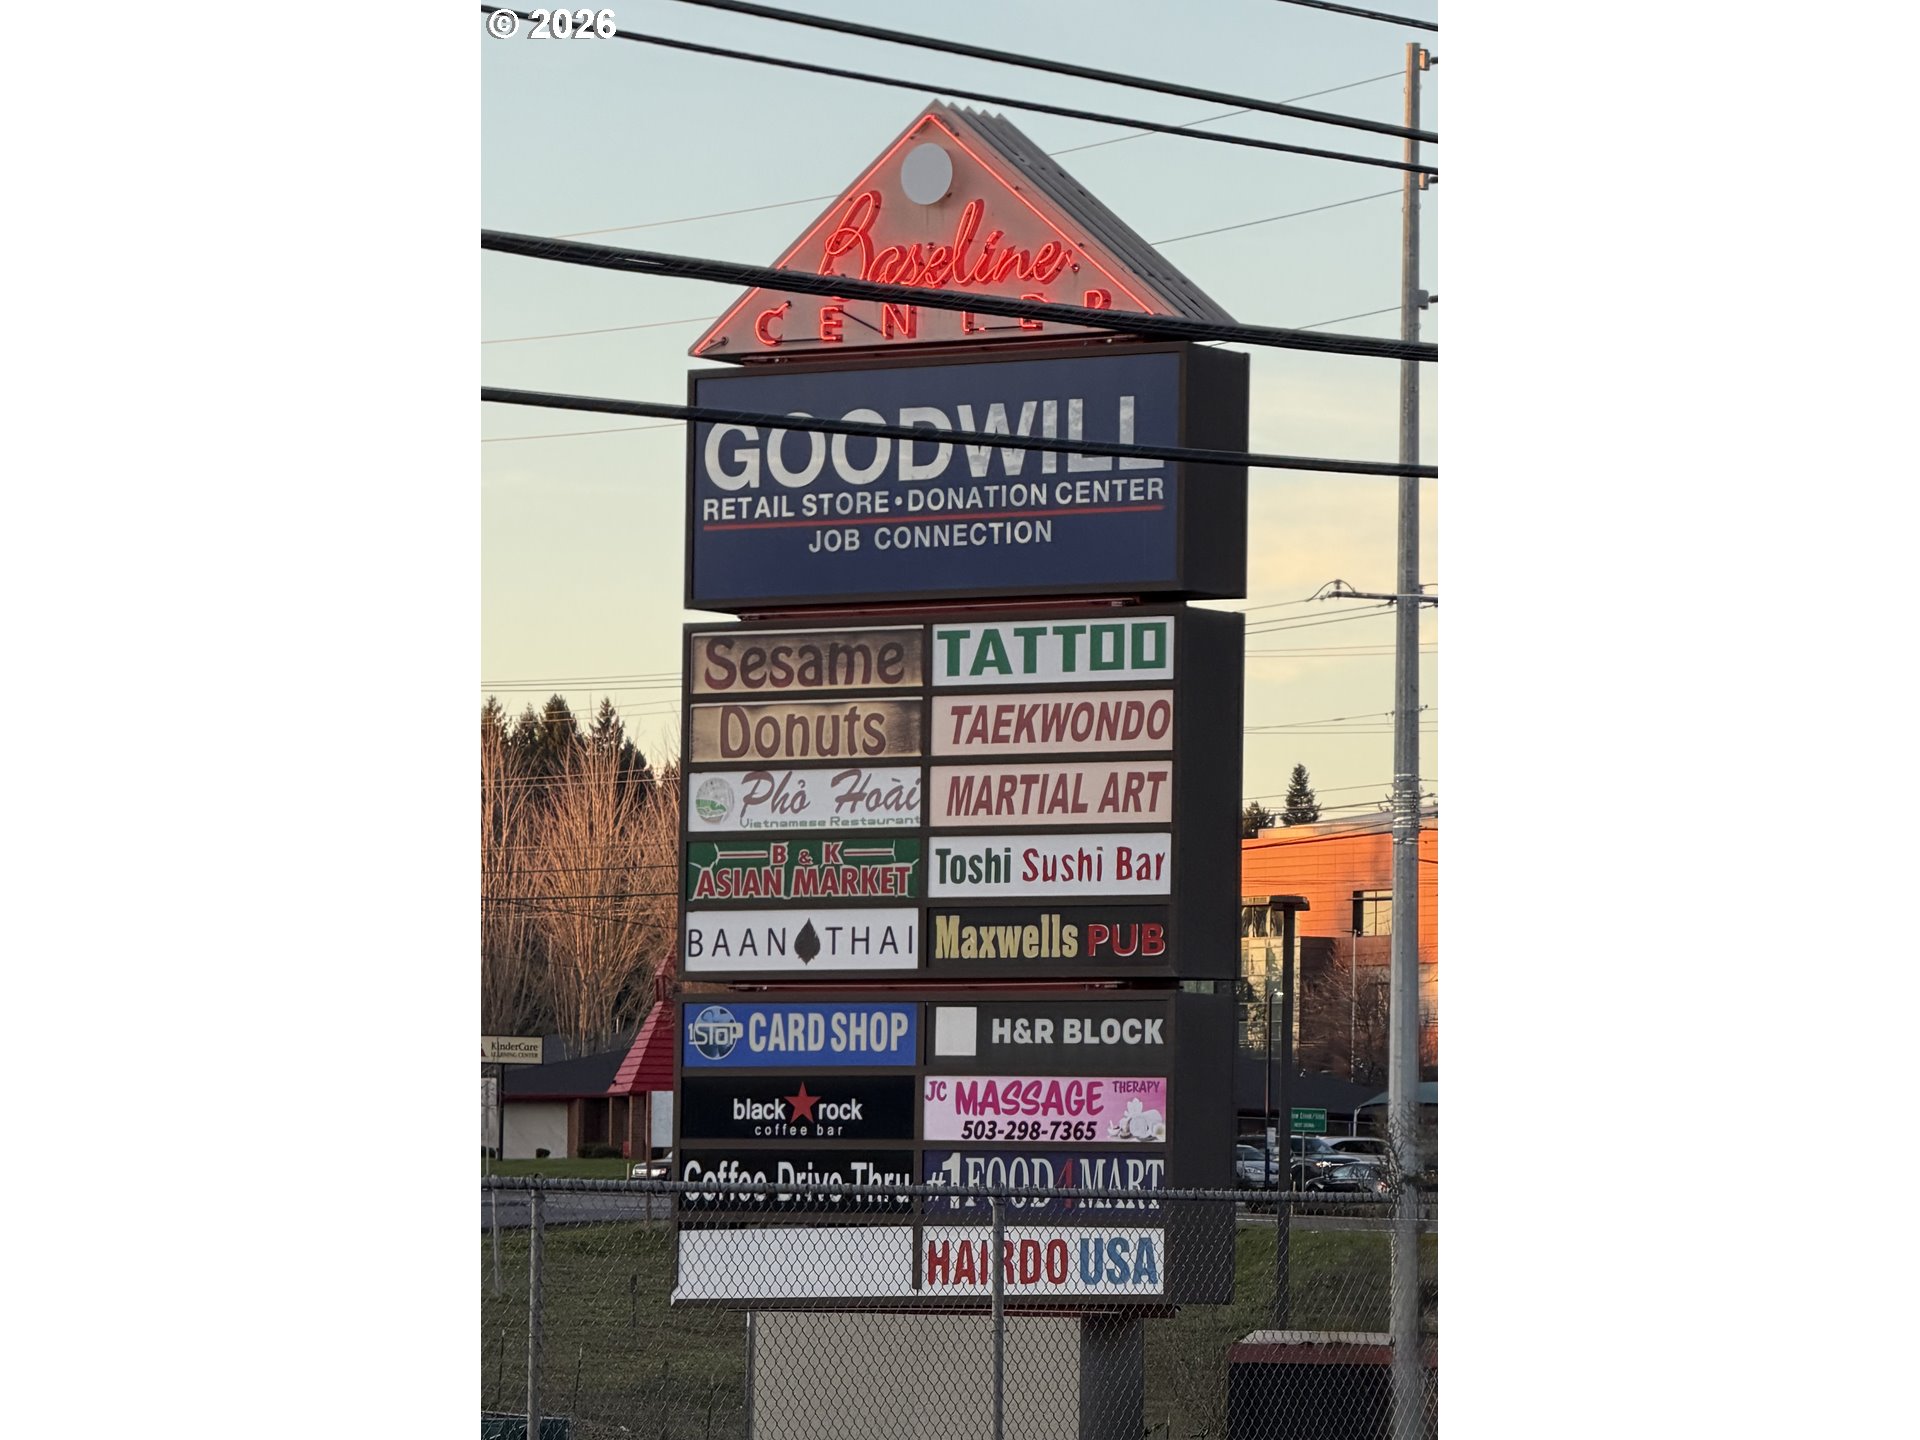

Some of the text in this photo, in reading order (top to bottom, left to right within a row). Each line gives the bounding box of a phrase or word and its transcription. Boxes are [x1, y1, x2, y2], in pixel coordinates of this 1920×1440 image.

[818, 189, 1074, 300] Baseline
[703, 395, 1165, 491] GOODWILL
[703, 477, 1165, 522] RETAIL STORE DONATION CENTER
[808, 519, 1053, 554] JOB CONNECTION
[704, 637, 906, 691] Sesame
[936, 621, 1167, 677] TATTOO
[719, 704, 887, 759] Donuts
[950, 699, 1172, 745] TAEKWONDO
[946, 770, 1168, 817] MARTIAL ART
[739, 815, 921, 829] Vietnamese Restaurant
[770, 840, 844, 866] B & K
[935, 846, 1166, 885] Toshi Sushi Bar
[693, 863, 913, 899] ASIAN MARKET
[687, 924, 913, 958] BAAN THAI
[935, 913, 1166, 960] Maxwells PUB
[748, 1011, 826, 1053] CARD
[831, 1011, 909, 1052] SHOP
[991, 1018, 1164, 1045] H&R BLOCK
[733, 1097, 863, 1121] black rock
[925, 1079, 1161, 1117] JC MASSAGE THERAPY
[754, 1123, 843, 1136] coffee bar
[960, 1120, 1098, 1141] 503-298-7365
[683, 1160, 767, 1202] Coffee
[927, 1236, 1159, 1286] HAIRDO USA
